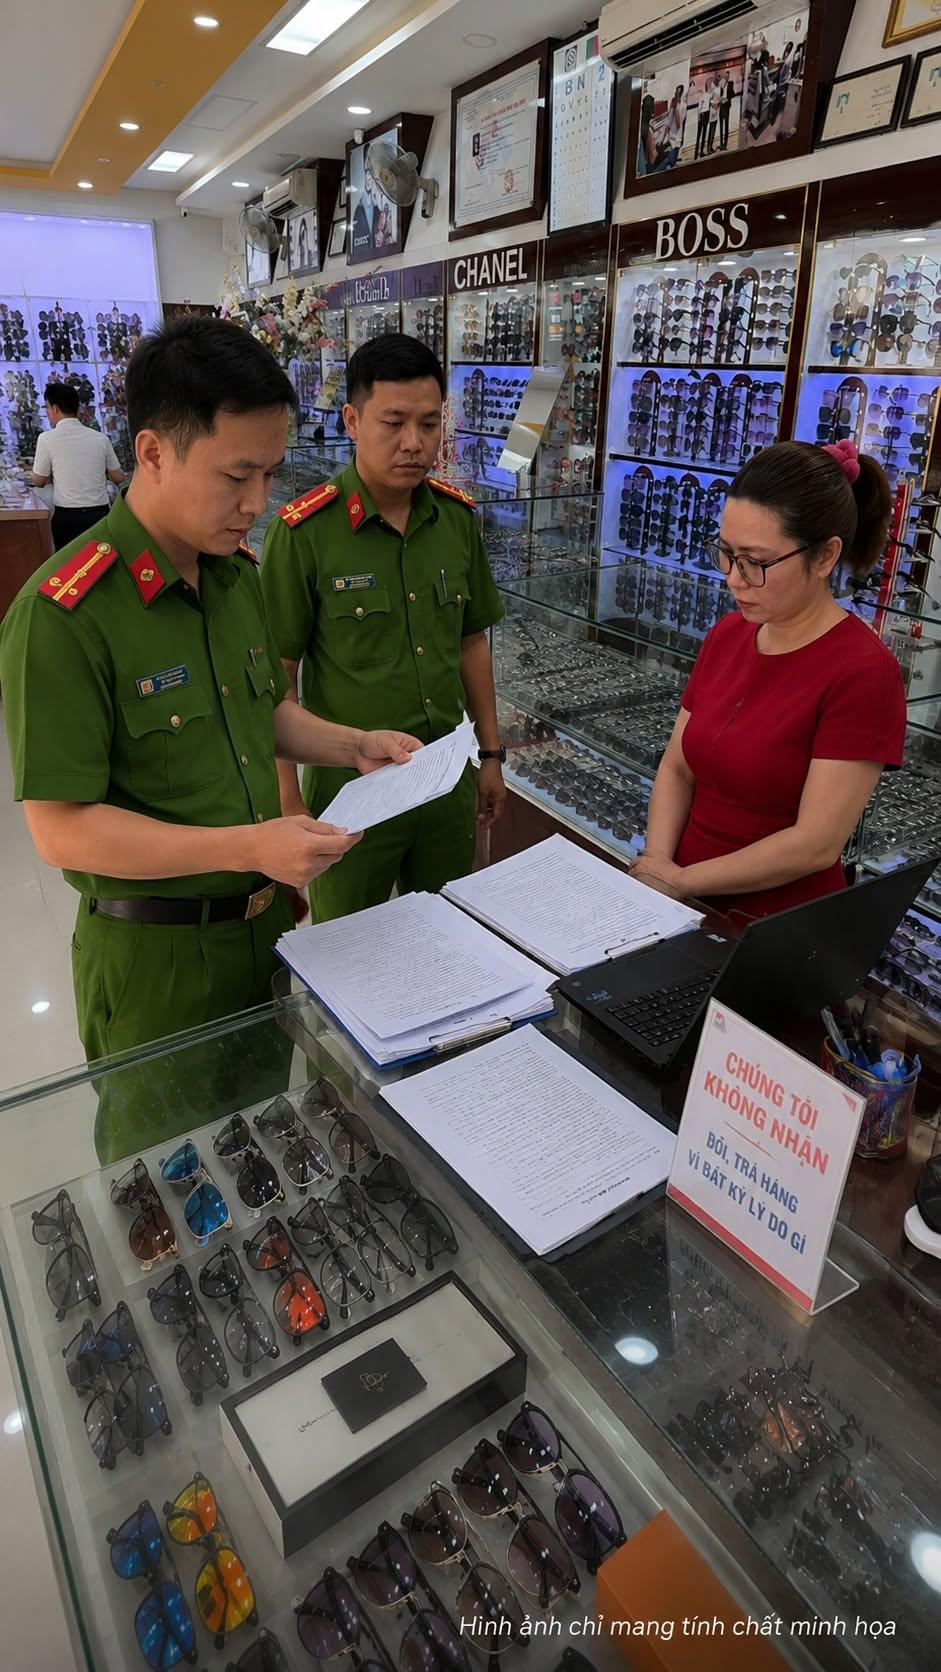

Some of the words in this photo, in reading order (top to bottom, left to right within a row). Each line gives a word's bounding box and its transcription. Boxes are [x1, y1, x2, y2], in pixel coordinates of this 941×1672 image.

[654, 202, 750, 261] BOSS
[453, 247, 528, 290] CHANEL
[725, 1051, 785, 1108] CHÚNG
[790, 1096, 819, 1131] TÔI
[704, 1071, 767, 1131] KHÔNG
[770, 1118, 830, 1176] NHẬN
[768, 1212, 788, 1240] DO
